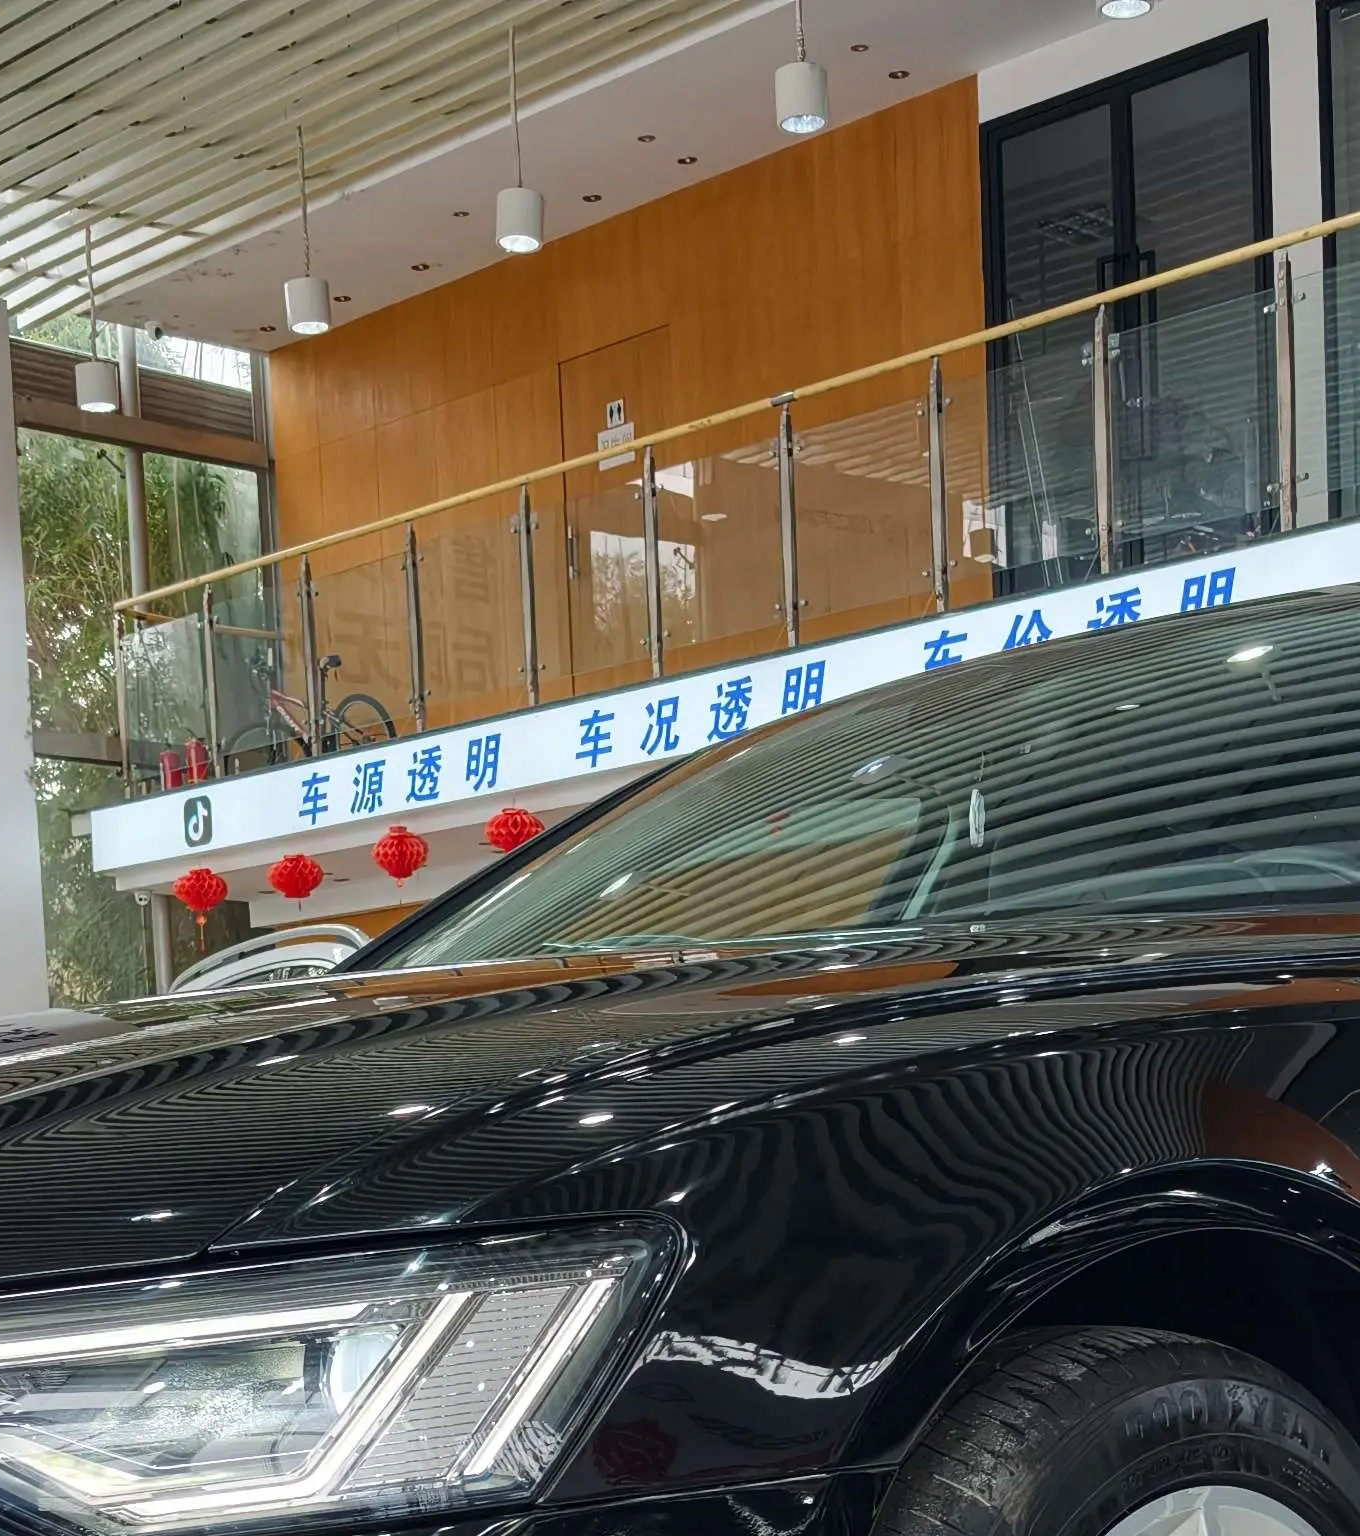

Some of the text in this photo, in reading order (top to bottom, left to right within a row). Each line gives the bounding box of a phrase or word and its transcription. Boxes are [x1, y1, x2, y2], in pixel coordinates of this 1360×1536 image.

[299, 732, 502, 826] 车源透明
[575, 660, 826, 768] 车况透明
